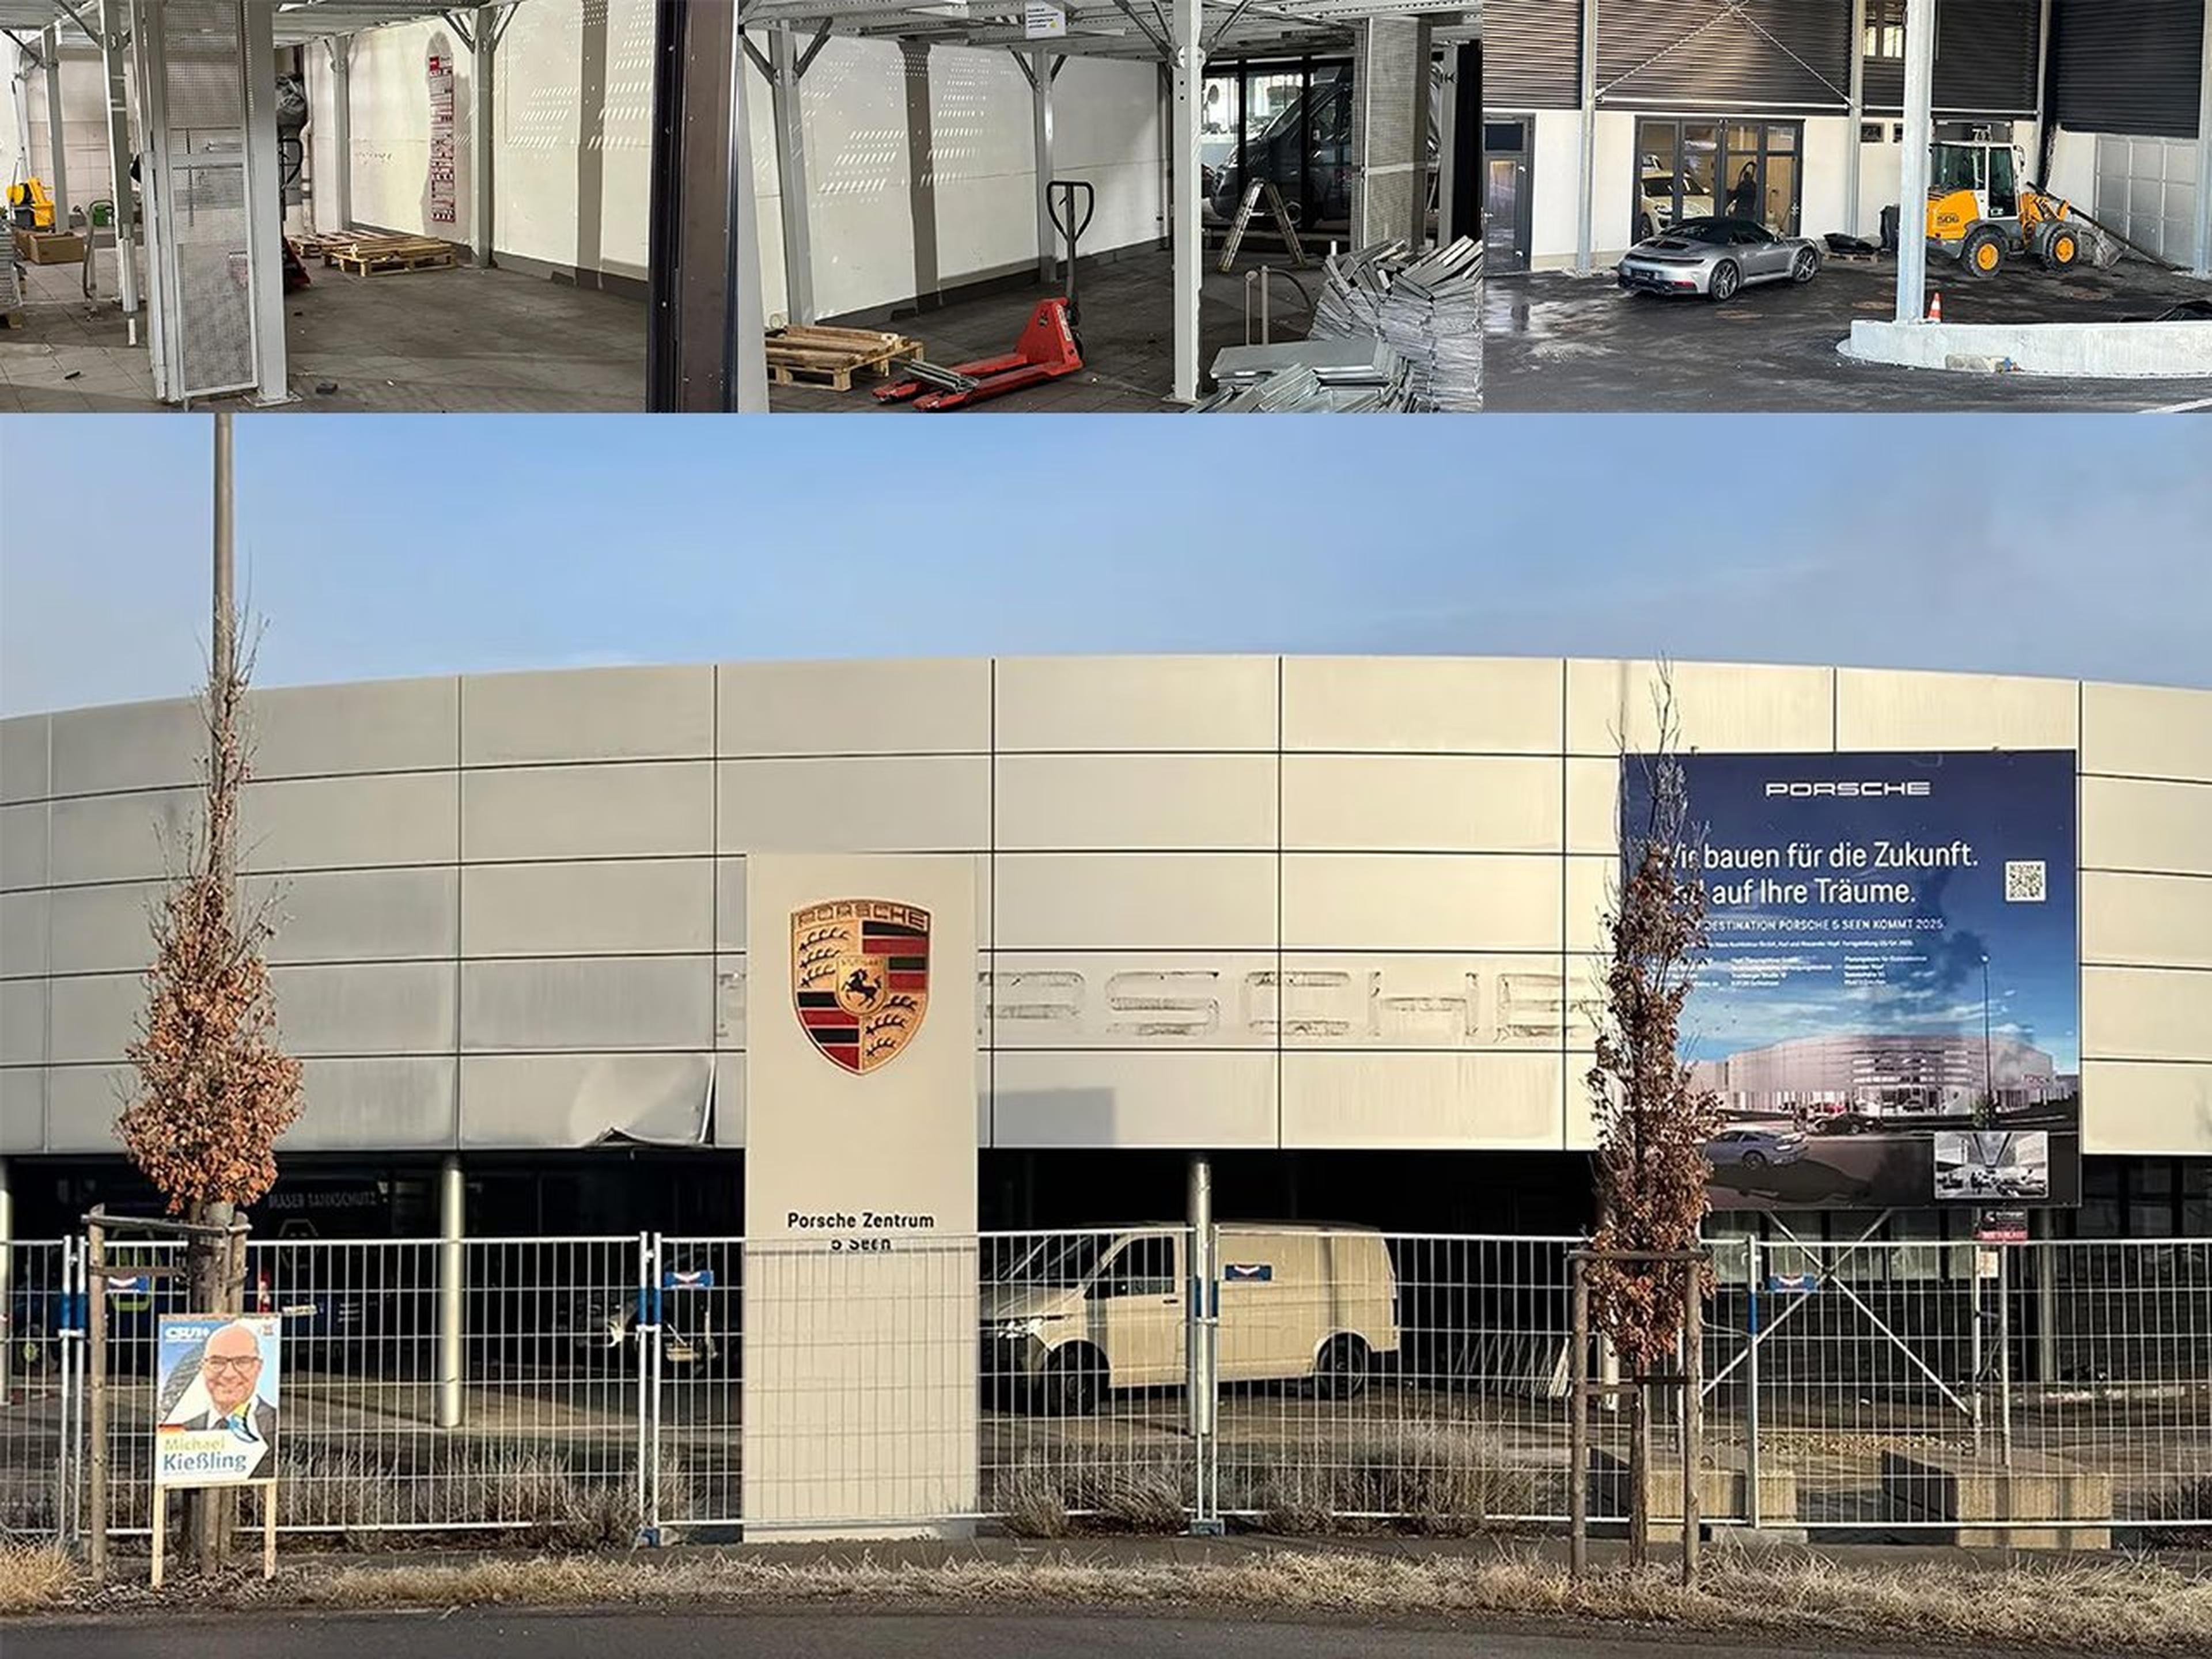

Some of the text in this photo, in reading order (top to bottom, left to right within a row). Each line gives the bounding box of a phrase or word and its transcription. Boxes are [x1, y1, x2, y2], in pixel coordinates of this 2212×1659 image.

[1766, 782, 1930, 796] PORSCHE
[1705, 843, 1779, 869] bauen
[1787, 843, 1822, 868] für
[1829, 842, 1867, 867] die
[1873, 842, 1978, 867] Zukunft.
[1711, 879, 1752, 904] auf
[1759, 879, 1808, 904] Ihre
[1815, 878, 1915, 904] Träume.
[797, 902, 926, 929] PORSCHE
[1778, 919, 1830, 931] PORSCHE
[787, 1212, 934, 1228] Porsche Zentrum
[165, 1435, 225, 1451] Michael
[164, 1451, 247, 1472] Kießling
